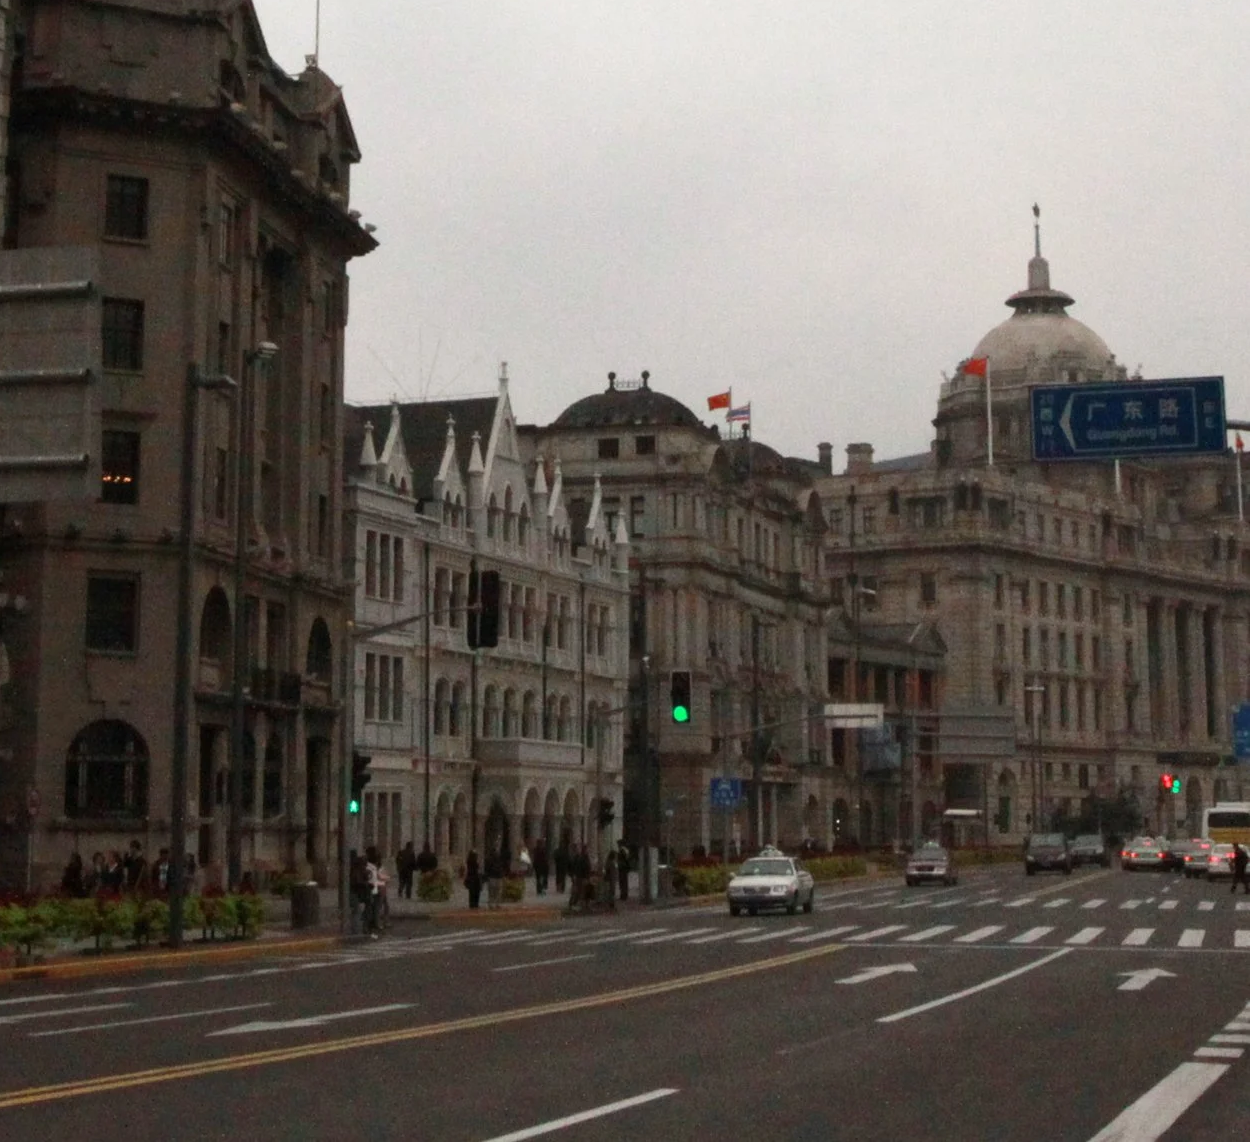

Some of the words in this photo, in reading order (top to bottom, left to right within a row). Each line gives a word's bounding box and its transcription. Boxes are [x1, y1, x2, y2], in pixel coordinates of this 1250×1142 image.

[1086, 398, 1180, 421] 广东路
[1086, 426, 1158, 442] Guangdong
